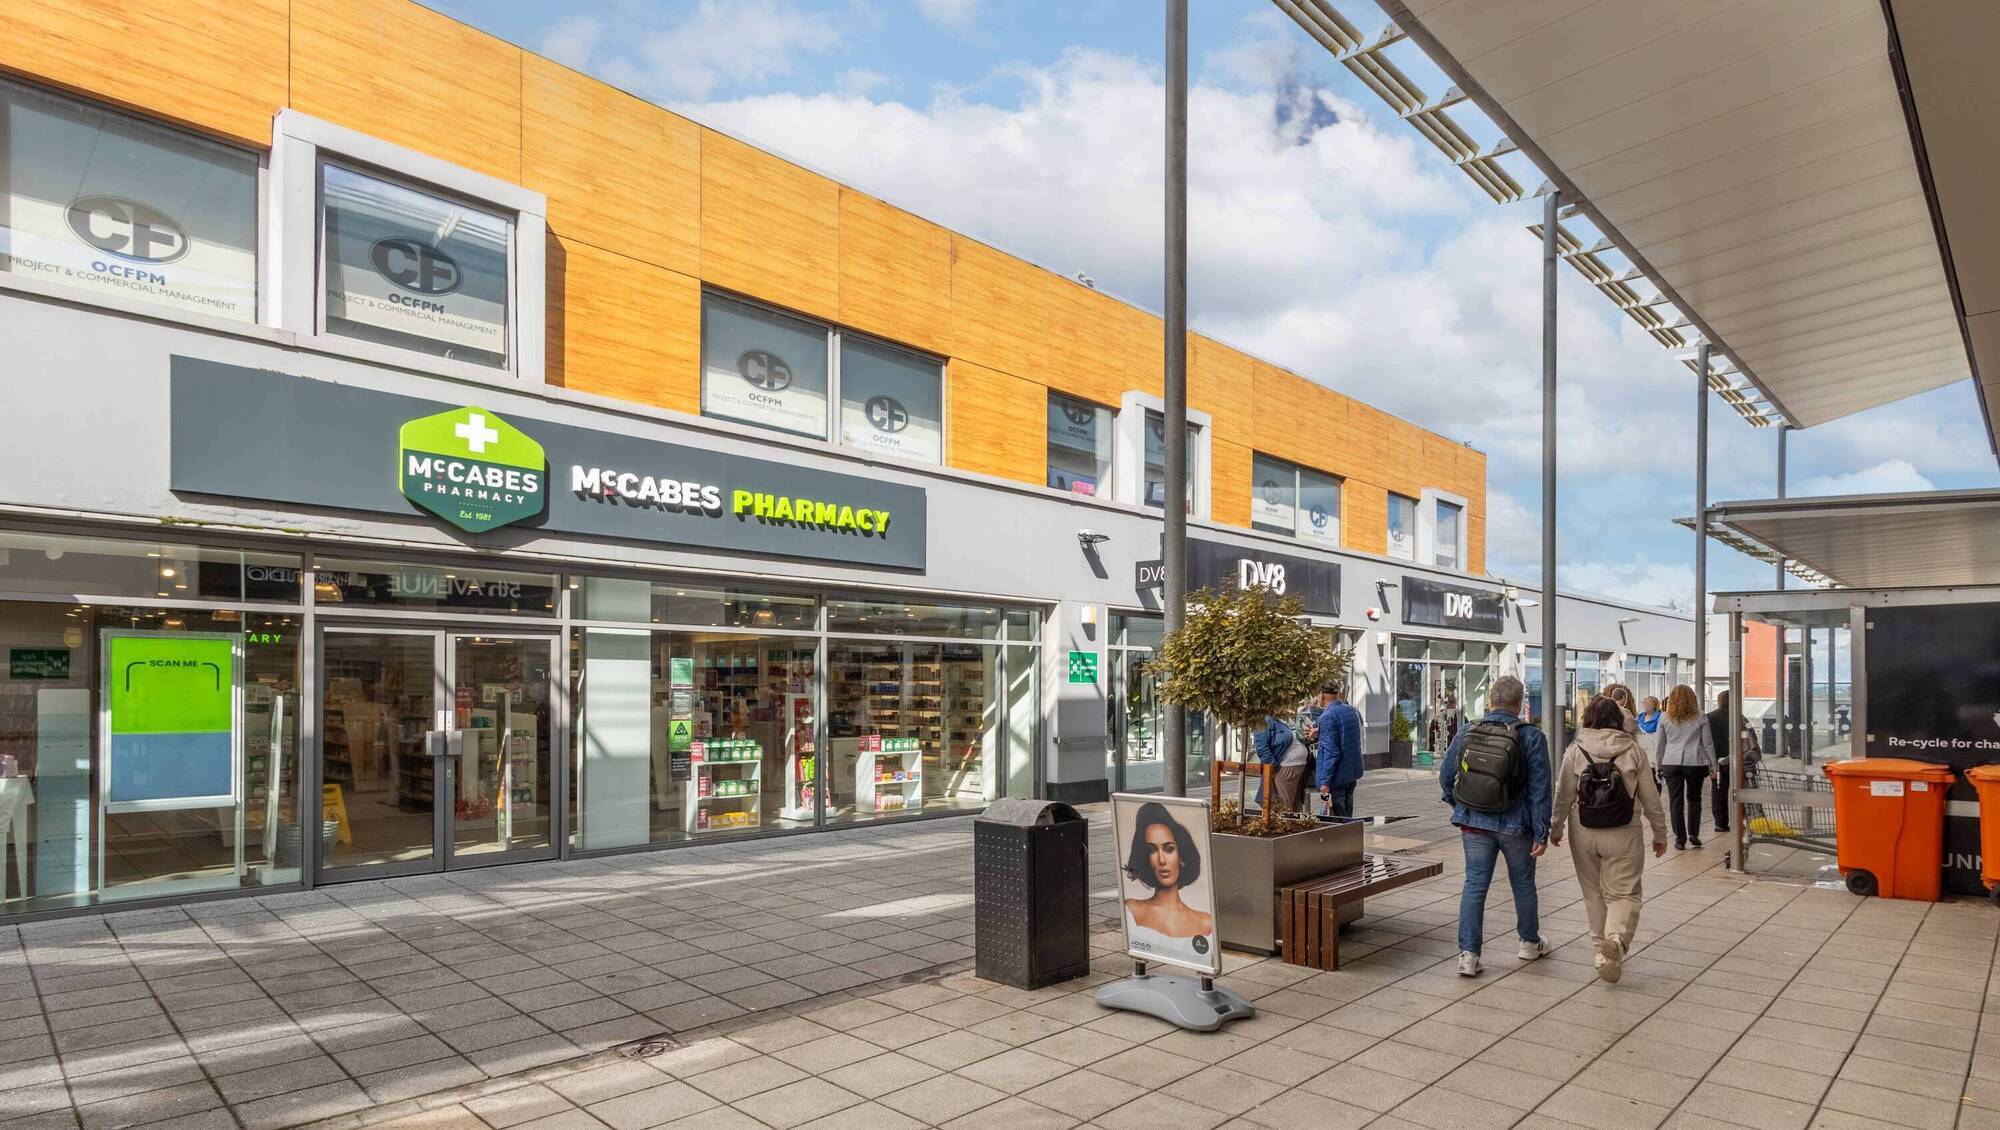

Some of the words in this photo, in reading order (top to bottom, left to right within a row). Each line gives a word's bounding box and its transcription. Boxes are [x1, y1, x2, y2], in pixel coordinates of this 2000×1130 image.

[8, 255, 61, 274] PROJECT
[65, 268, 73, 277] &
[77, 270, 156, 293] COMMERCIAL
[159, 288, 238, 311] MANAGEMENT
[91, 260, 166, 286] OCFPM
[388, 293, 445, 314] OCFPM
[377, 303, 437, 321] COMMERCIAL
[438, 316, 498, 335] MANAGEMENT
[748, 392, 783, 407] OCFPM
[873, 434, 901, 447] OCFPM
[424, 482, 525, 504] PHARMACY
[459, 510, 473, 520] Est
[475, 511, 492, 521] 1981
[732, 489, 890, 534] PHARMACY
[1238, 559, 1286, 596] DV8
[1444, 592, 1473, 620] DV8
[242, 633, 281, 643] ARY
[150, 660, 181, 668] SCAN
[183, 660, 199, 668] ME
[1888, 736, 1949, 749] Re-cycle
[1952, 738, 1974, 749] for
[1975, 739, 2000, 750] cha
